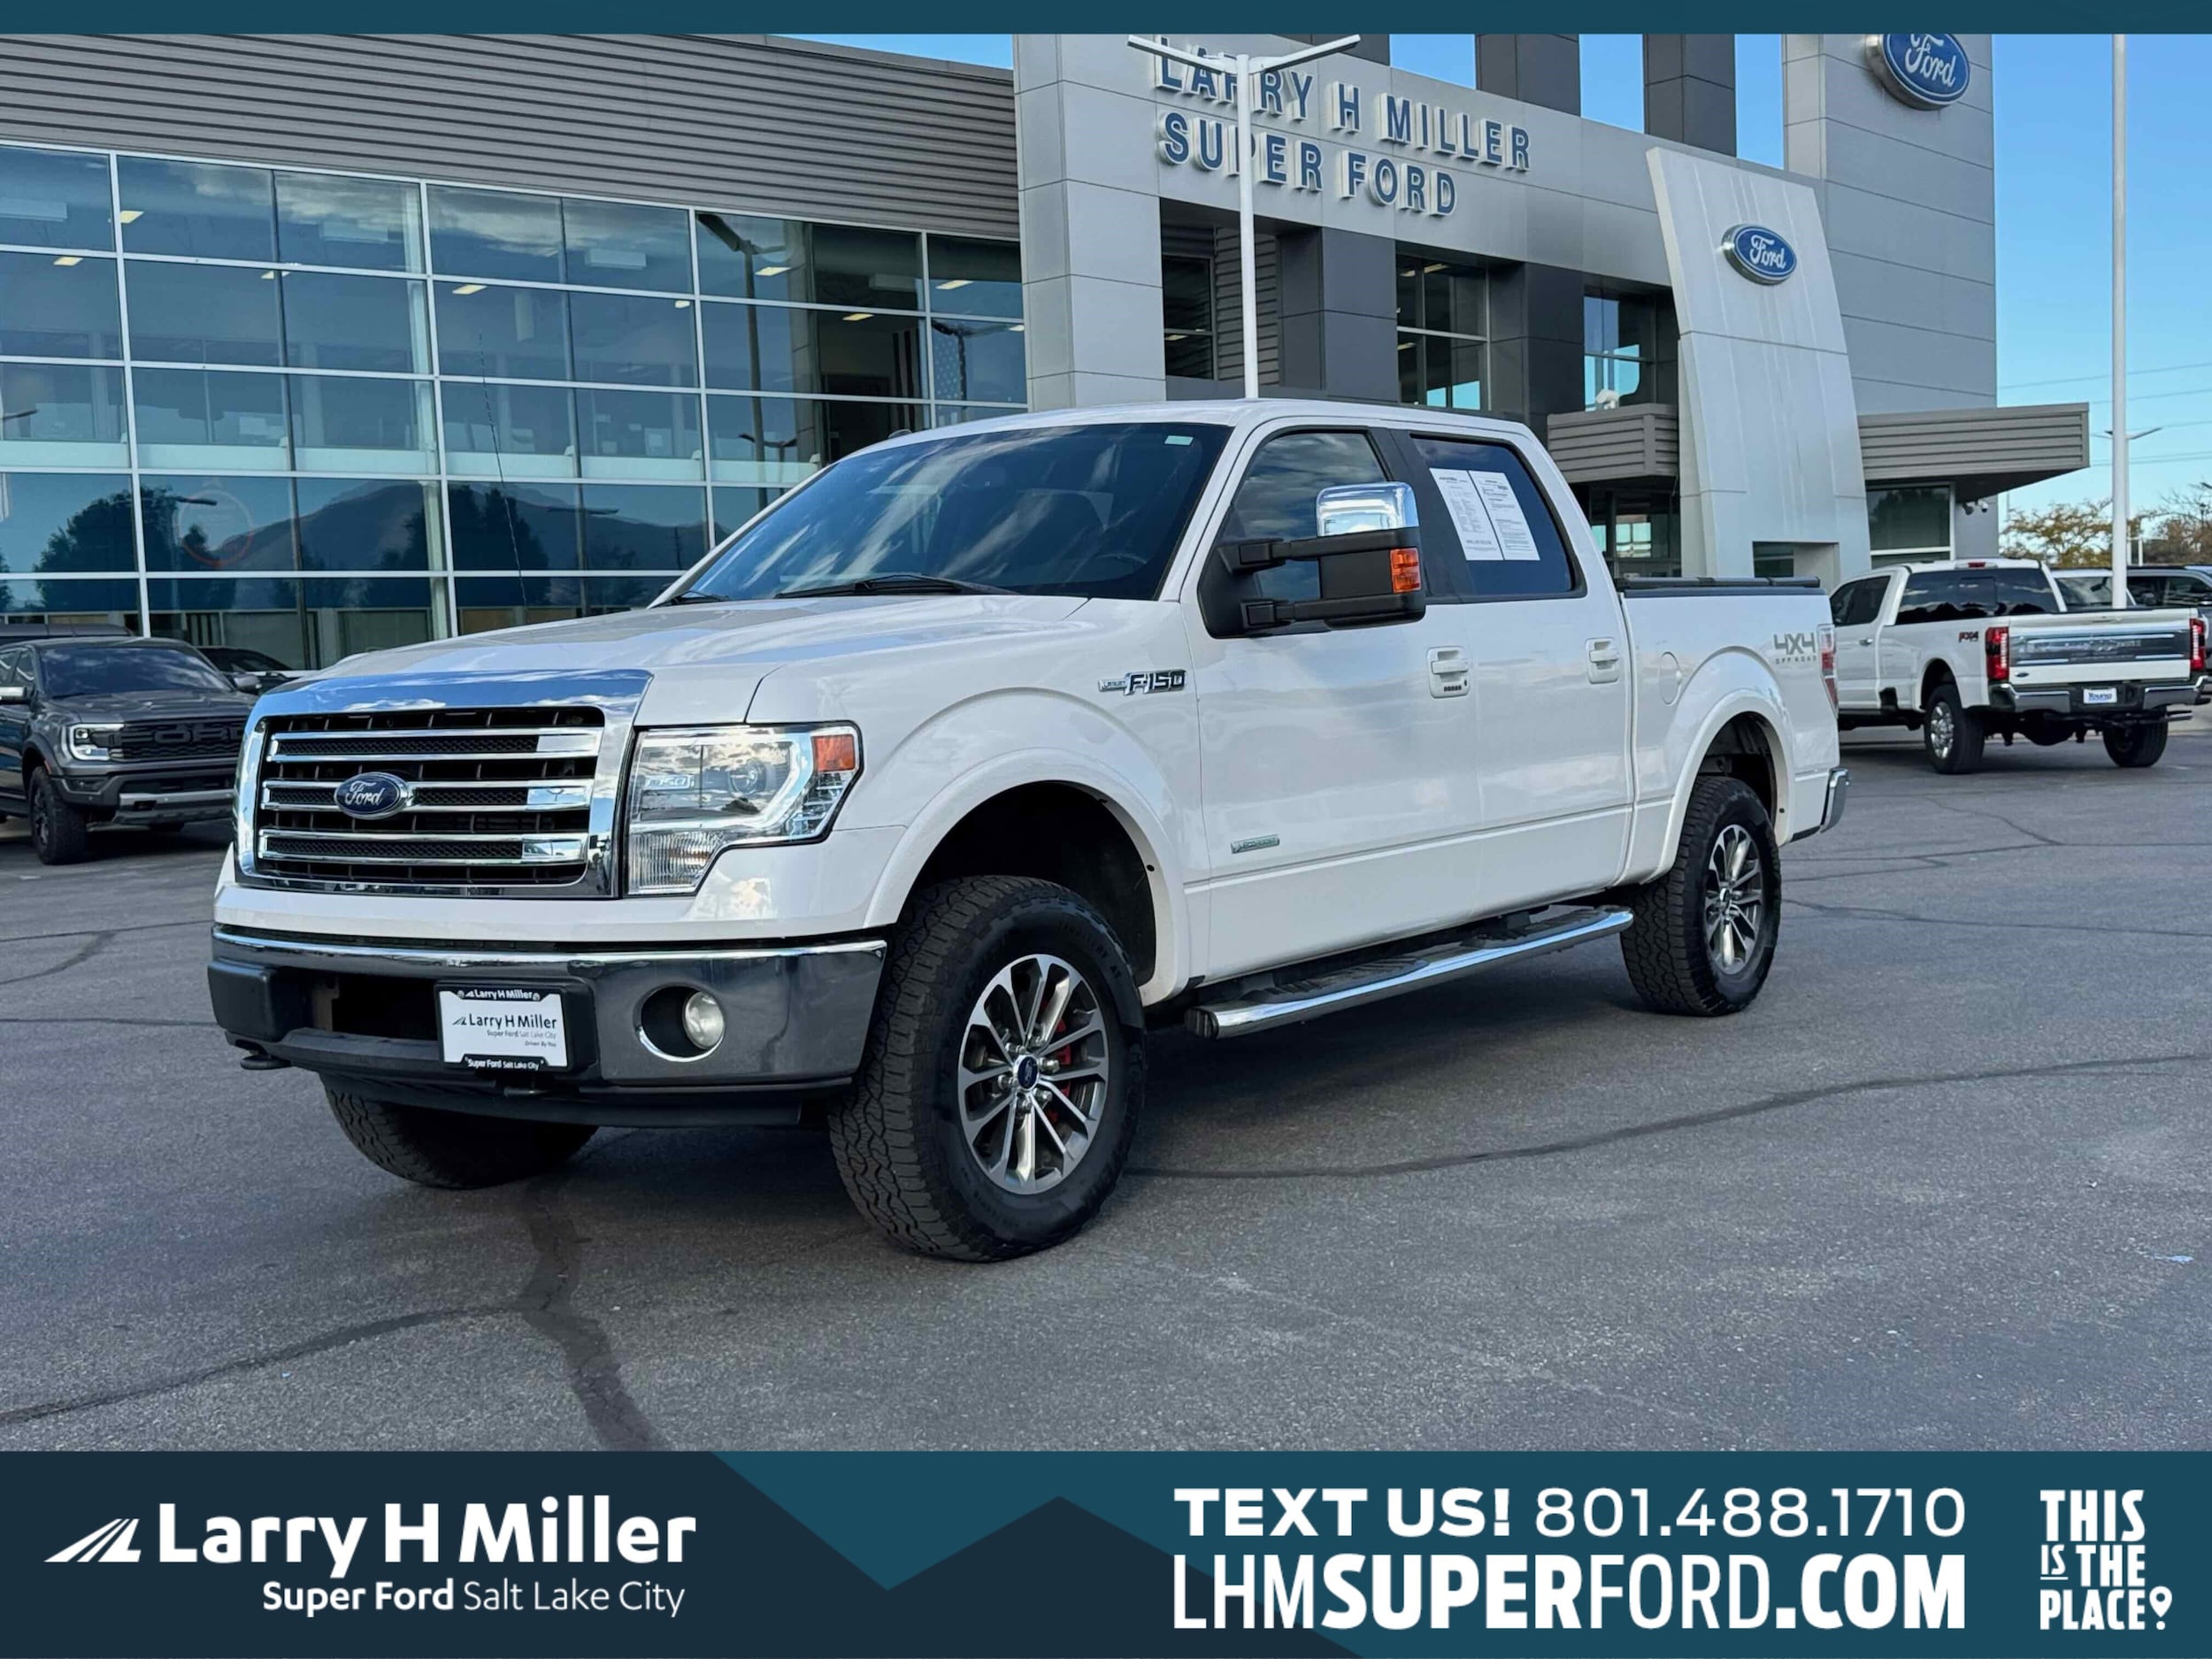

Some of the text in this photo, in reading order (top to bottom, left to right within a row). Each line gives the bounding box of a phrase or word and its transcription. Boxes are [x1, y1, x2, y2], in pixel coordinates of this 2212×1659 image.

[1333, 81, 1362, 133] H
[1380, 92, 1531, 172] MILLER
[1340, 150, 1456, 216] FORD
[1749, 234, 1786, 270] Ford
[344, 780, 386, 806] Ford
[474, 989, 496, 1000] Larry
[506, 989, 533, 999] Miller
[469, 1013, 557, 1030] Larry H Miller
[467, 1059, 486, 1069] Super
[487, 1059, 502, 1068] Ford
[527, 1062, 540, 1071] City
